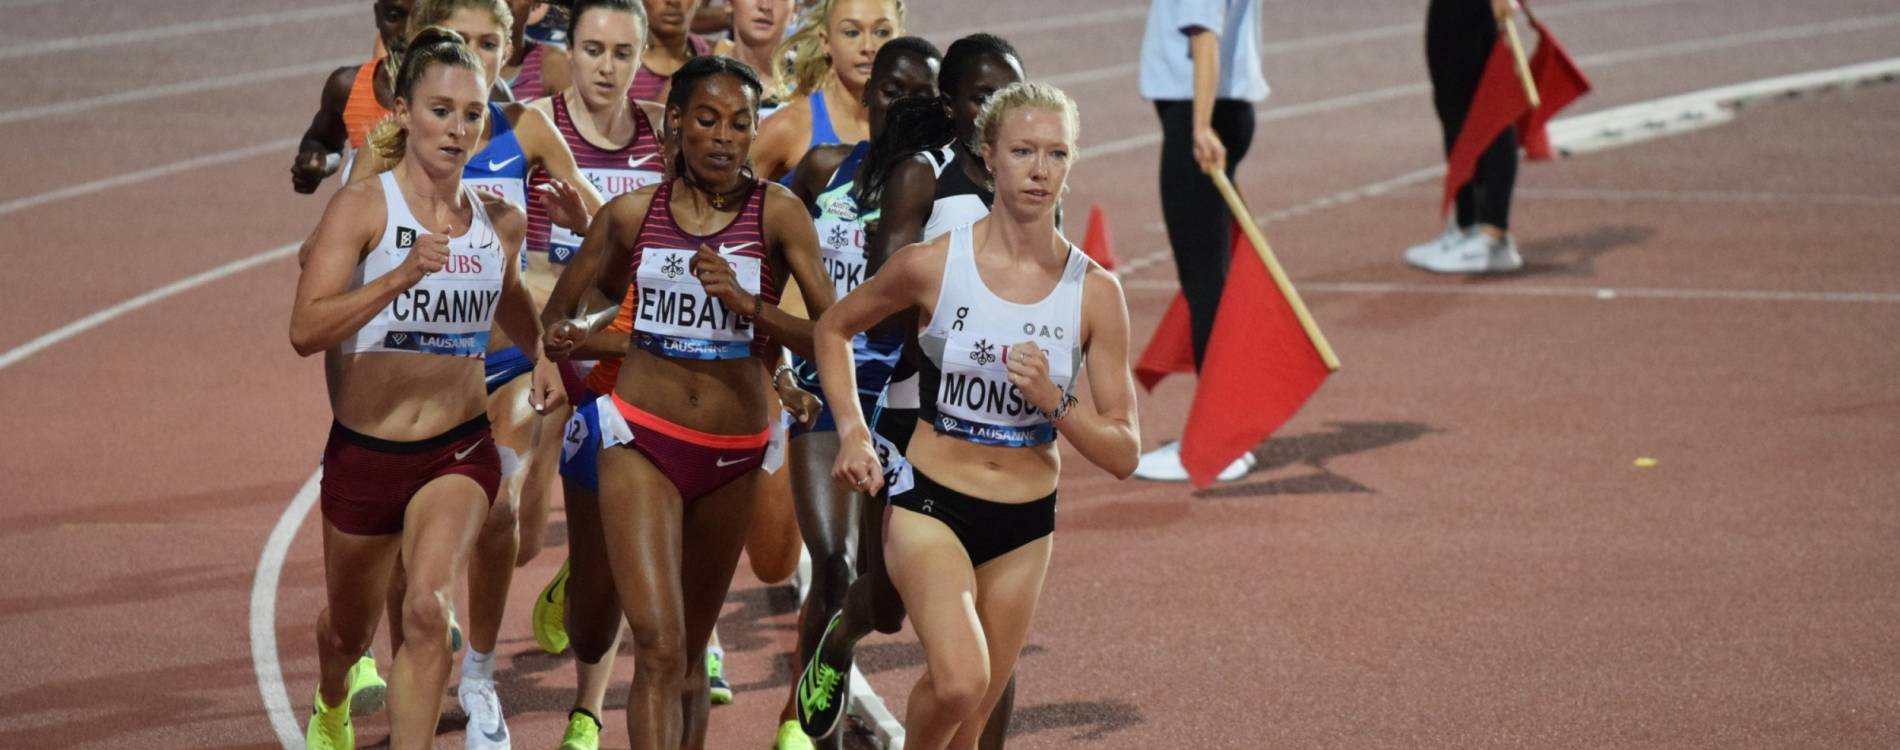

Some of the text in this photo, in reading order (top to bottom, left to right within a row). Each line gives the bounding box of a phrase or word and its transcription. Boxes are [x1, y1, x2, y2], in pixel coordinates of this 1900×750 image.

[470, 184, 505, 197] BS
[607, 175, 646, 194] UBS
[445, 254, 483, 274] UBS
[822, 257, 863, 293] IPK
[392, 288, 500, 323] CRANNY
[1023, 322, 1064, 340] OAC
[420, 334, 477, 349] LAUSANNE
[663, 339, 730, 354] LAUSANNE
[943, 372, 1041, 417] MONS
[968, 425, 1036, 442] LAUSANNE
